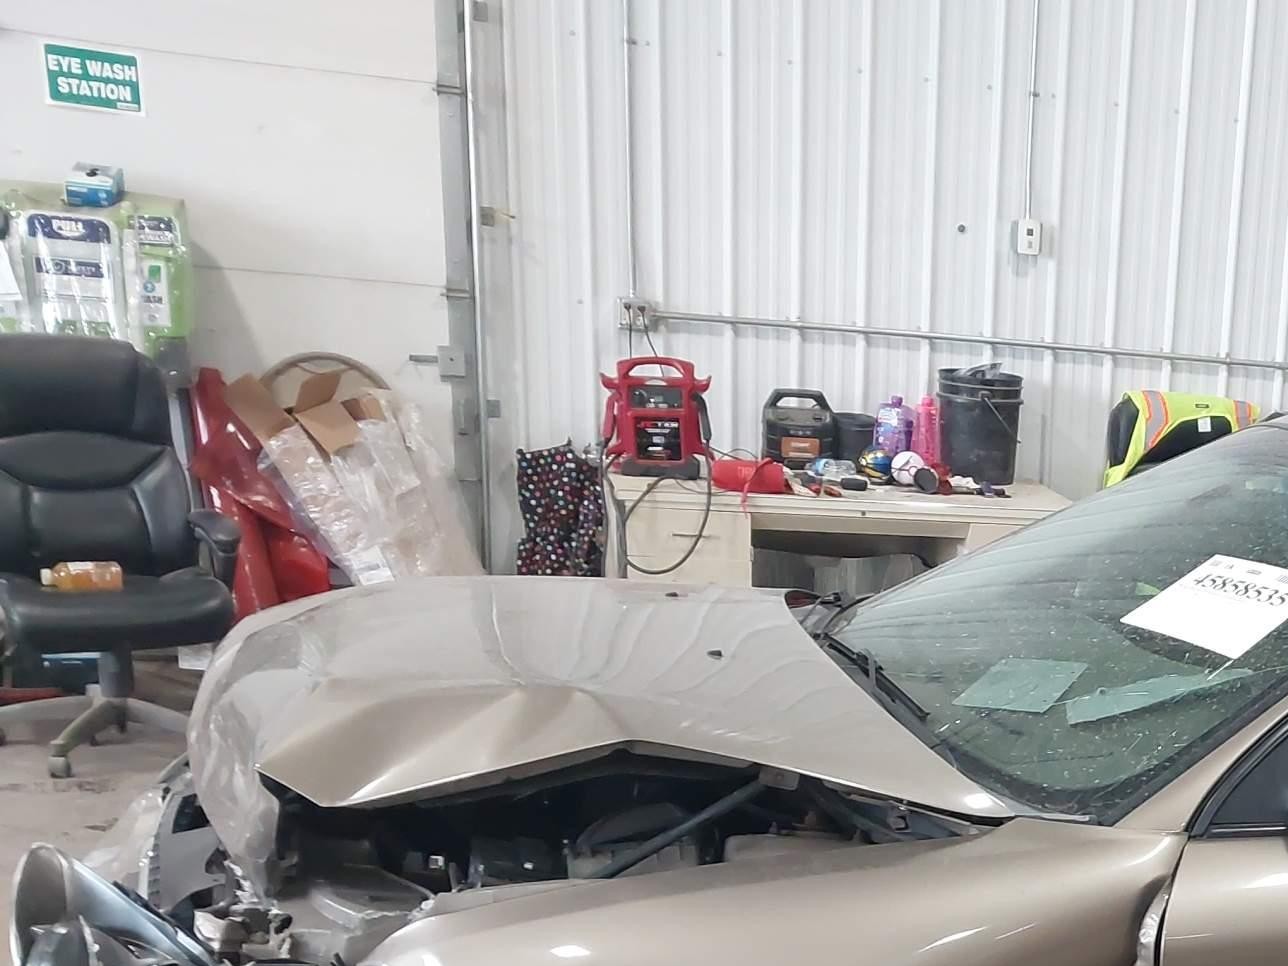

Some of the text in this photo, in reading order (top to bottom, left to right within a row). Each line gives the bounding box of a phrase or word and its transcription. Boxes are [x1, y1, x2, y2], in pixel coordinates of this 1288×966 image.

[47, 53, 136, 82] EYE WASH
[57, 76, 132, 102] STATION
